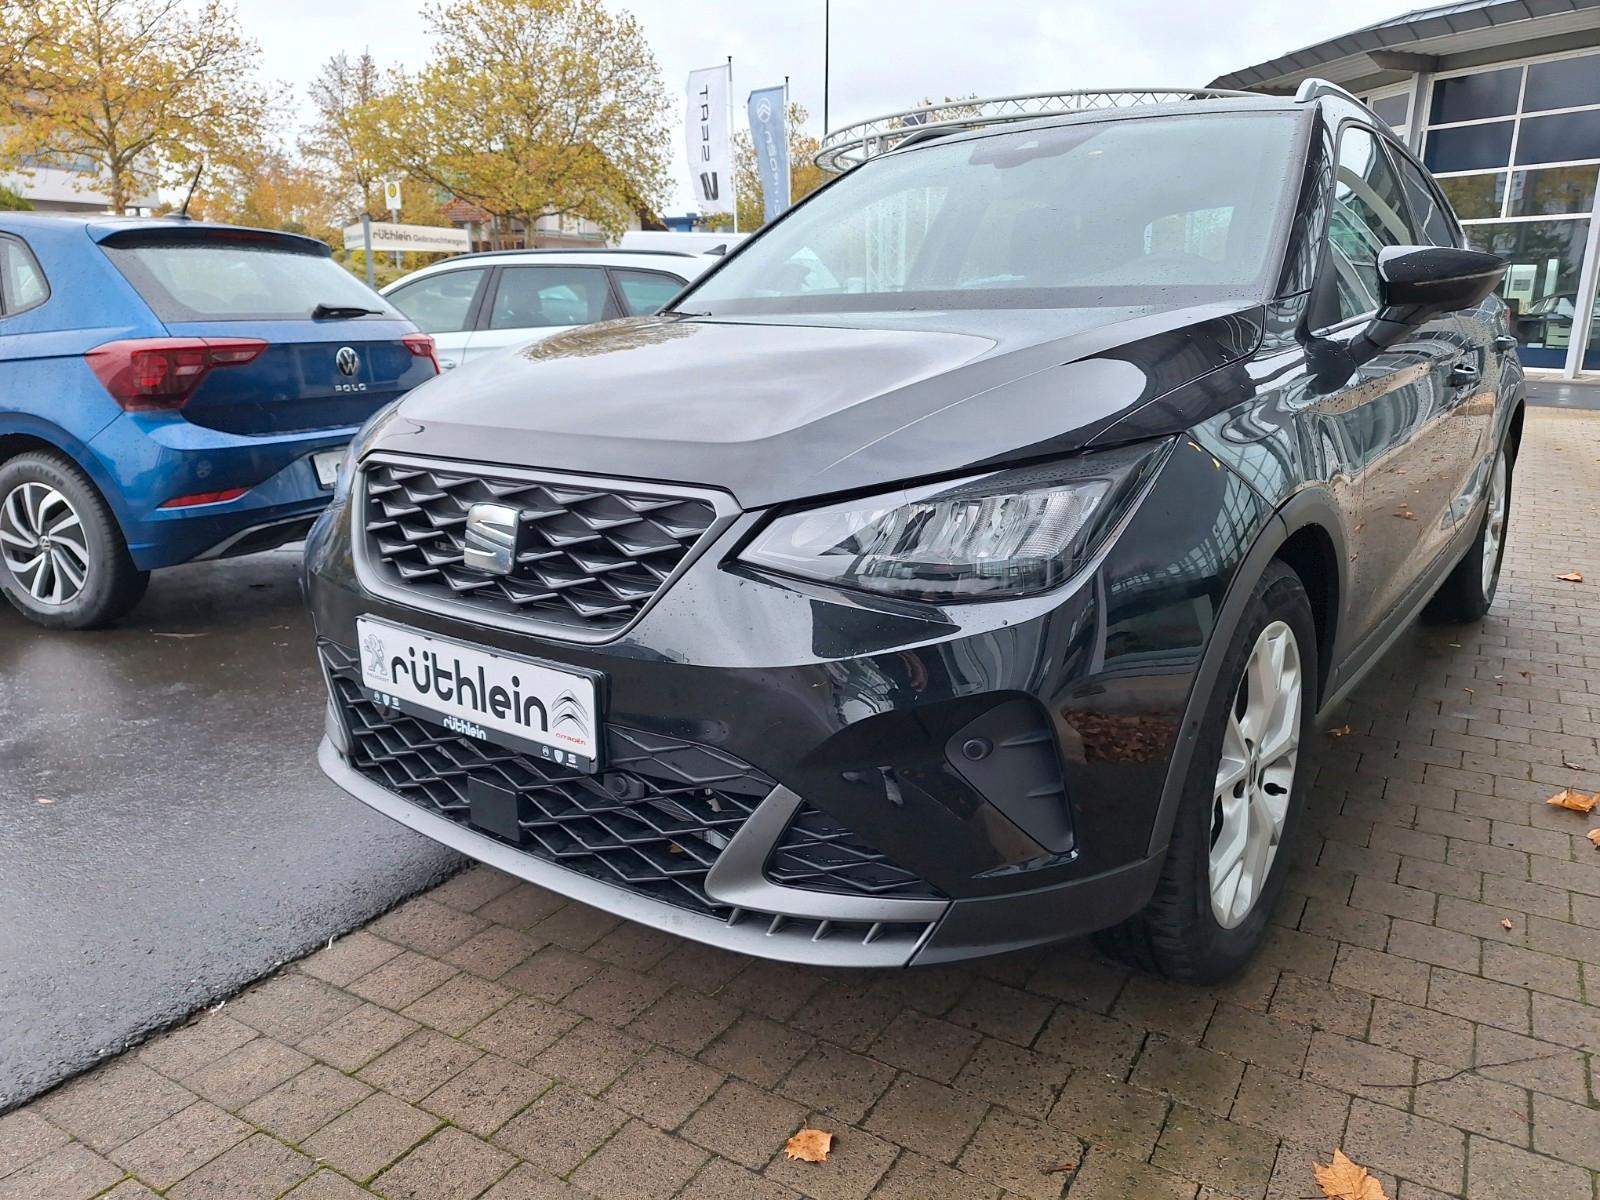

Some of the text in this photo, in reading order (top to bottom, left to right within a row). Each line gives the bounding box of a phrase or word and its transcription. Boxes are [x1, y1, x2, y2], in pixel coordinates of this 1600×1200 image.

[372, 228, 412, 241] rüthlein
[335, 382, 368, 392] POLO
[391, 646, 548, 732] rüthlein
[443, 715, 487, 741] rüthlein
